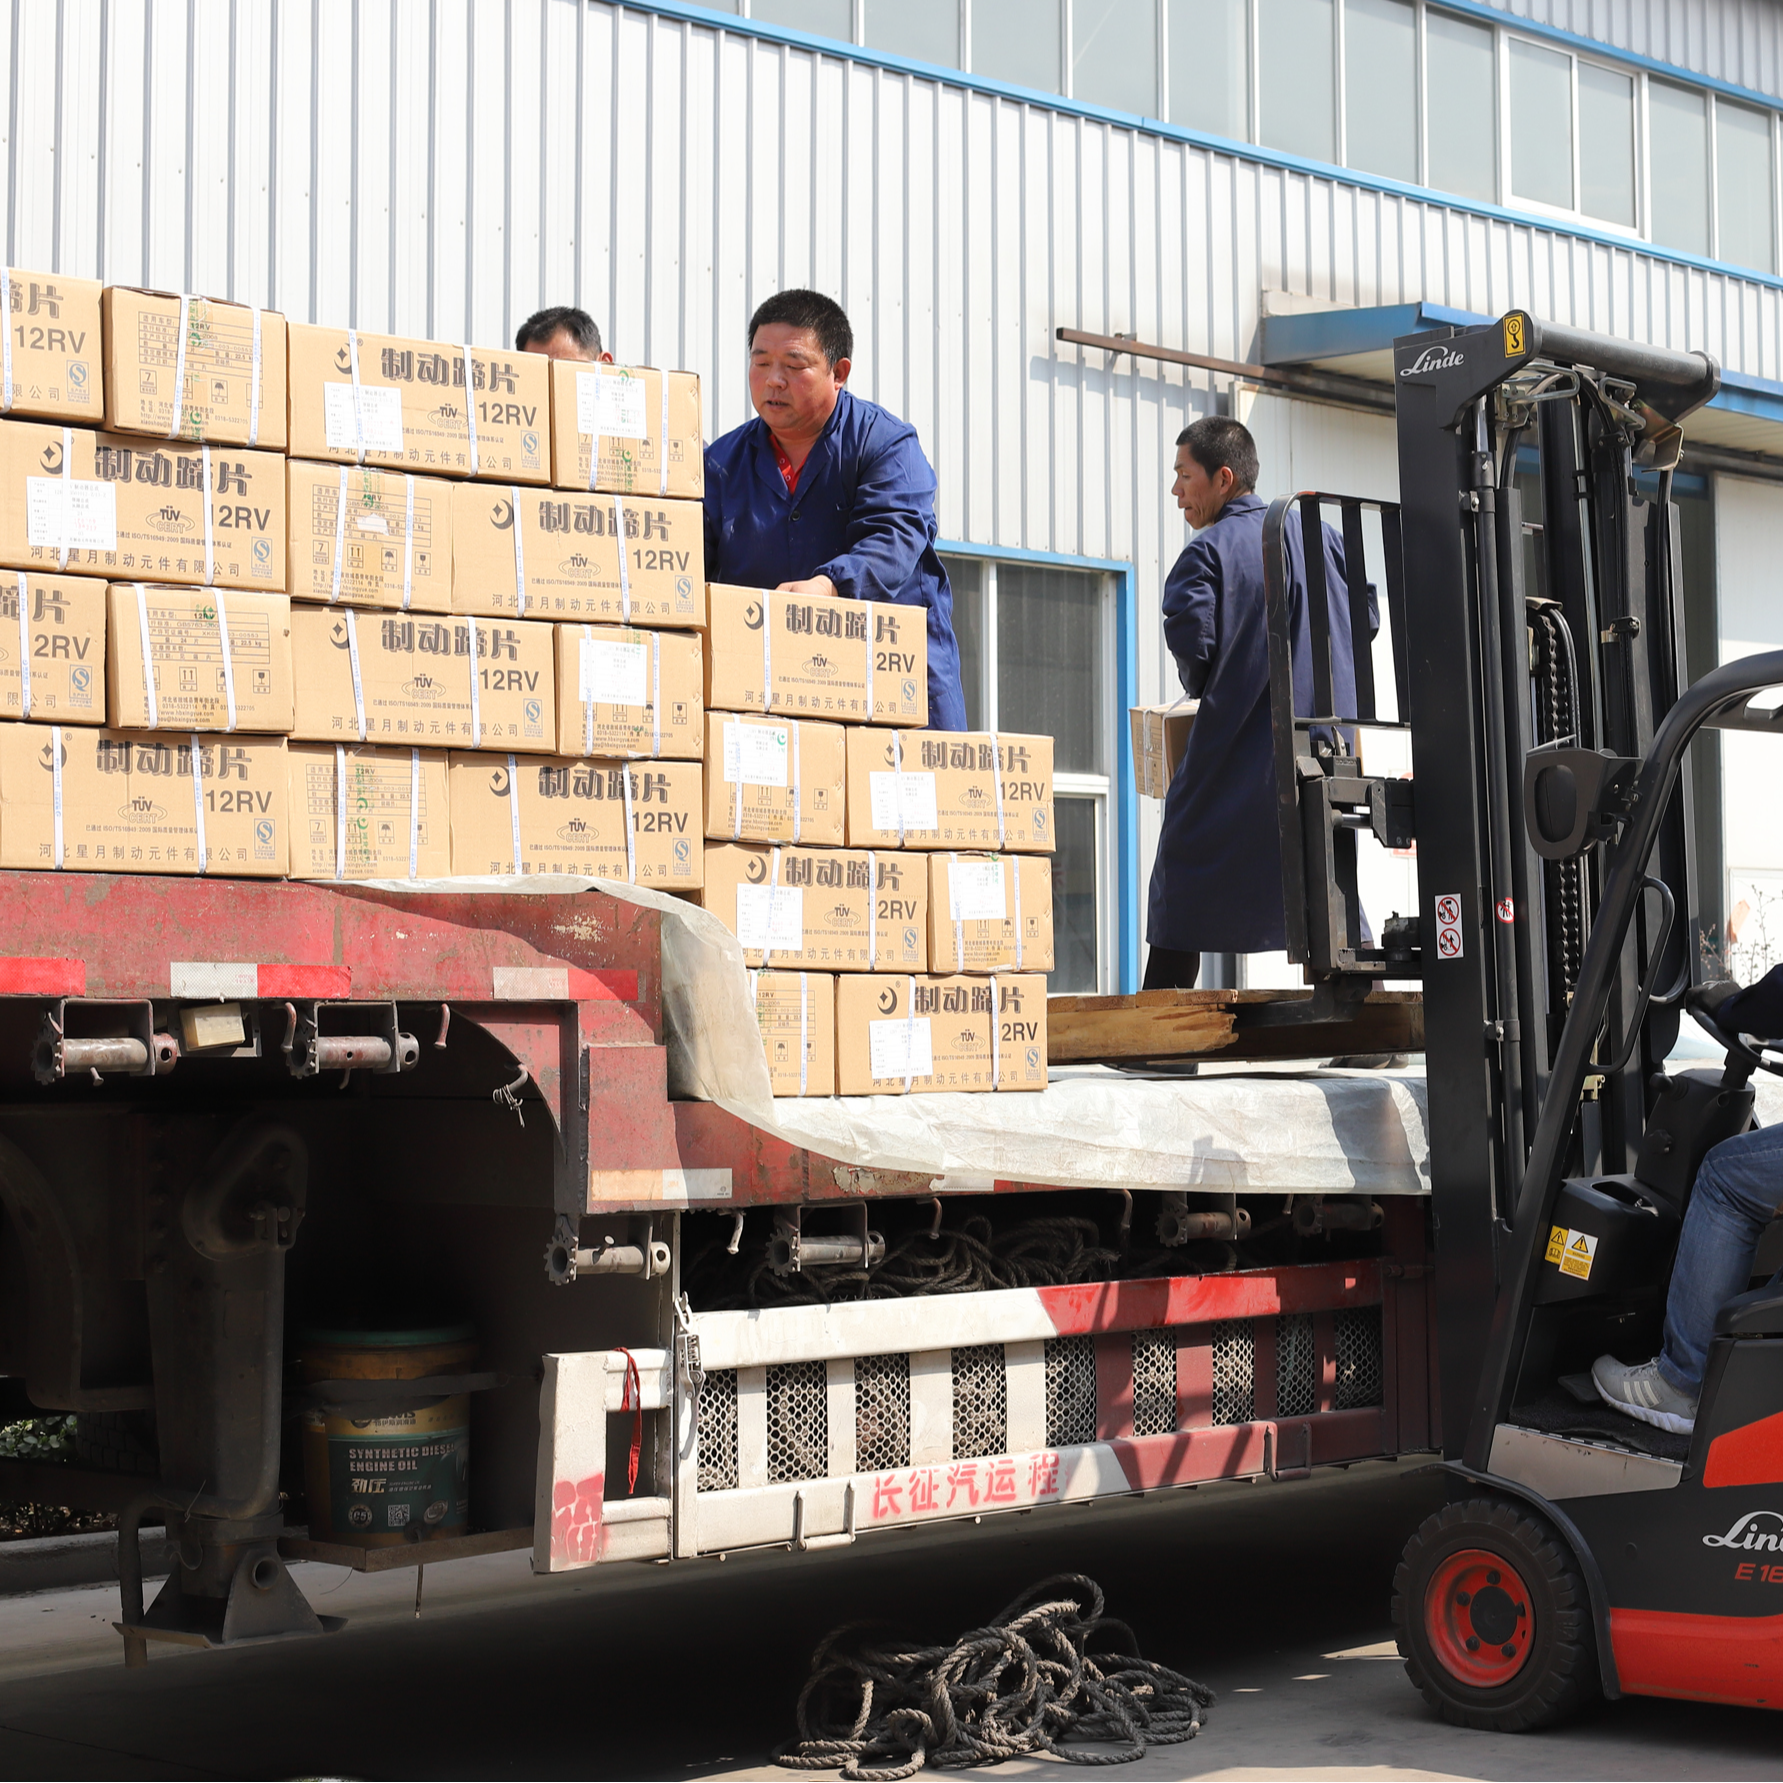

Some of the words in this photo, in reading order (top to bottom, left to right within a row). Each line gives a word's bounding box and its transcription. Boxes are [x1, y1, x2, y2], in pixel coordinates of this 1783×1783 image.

[15, 325, 86, 353] 12RV
[381, 347, 519, 394] 制动蹄片
[1400, 345, 1464, 377] Linde
[439, 403, 458, 418] TÜV
[479, 402, 537, 427] 12RV
[94, 446, 252, 496] 制动蹄片
[160, 506, 180, 521] TÜV
[539, 501, 671, 541] 制动蹄片
[570, 553, 588, 567] TÜV
[633, 549, 690, 571] 12RV
[786, 604, 900, 644] 制动蹄片
[381, 620, 520, 661] 制动蹄片
[812, 654, 828, 667] TÜV
[414, 674, 432, 688] TÜV
[480, 669, 539, 691] 12RV
[96, 740, 251, 781] 制动蹄片
[922, 741, 1031, 774] 制动蹄片
[539, 767, 671, 803] 制动蹄片
[968, 786, 983, 798] TÜV
[1000, 782, 1045, 801] 12RV
[132, 796, 152, 811] TÜV
[205, 791, 272, 813] 12RV
[569, 818, 586, 832] TÜV
[632, 812, 688, 833] 12RV
[785, 857, 903, 891] 制动蹄片
[835, 904, 850, 916] TÜV
[960, 1030, 975, 1042] TÜV
[349, 1447, 419, 1459] SYNTHETIC
[350, 1460, 394, 1472] ENGINE
[397, 1460, 418, 1471] OIL
